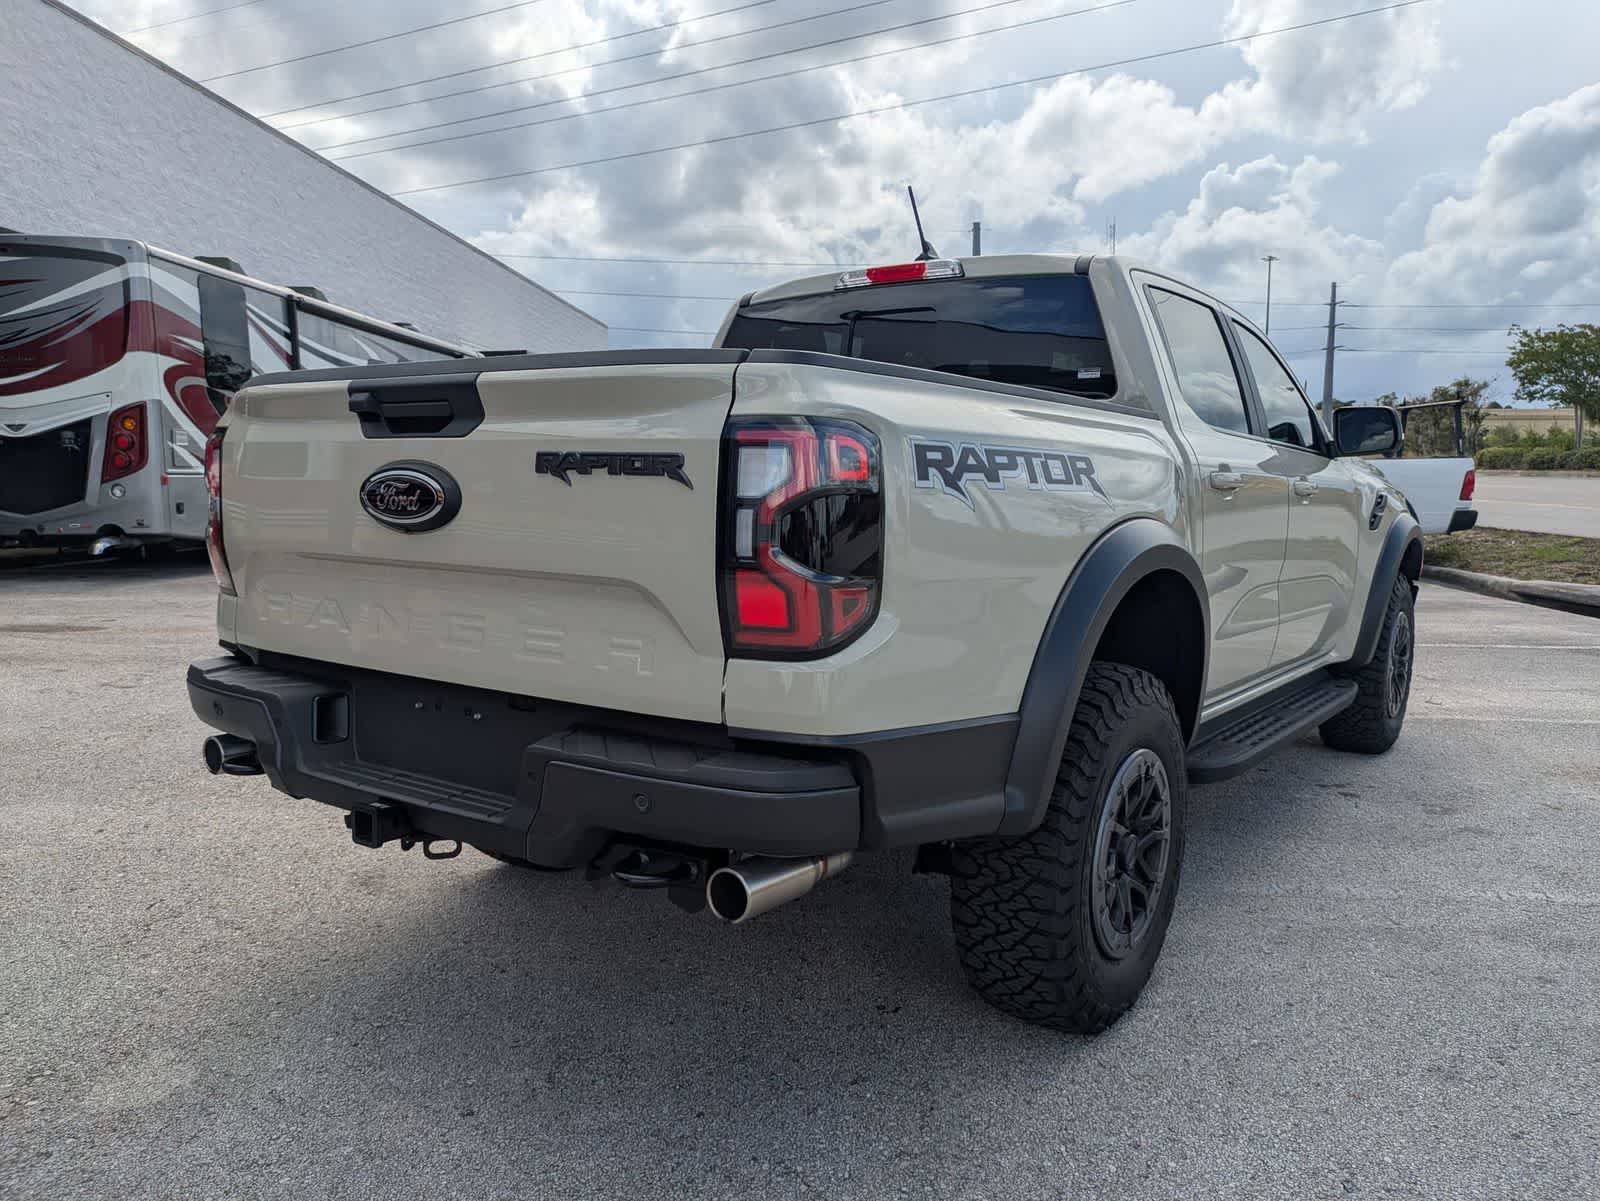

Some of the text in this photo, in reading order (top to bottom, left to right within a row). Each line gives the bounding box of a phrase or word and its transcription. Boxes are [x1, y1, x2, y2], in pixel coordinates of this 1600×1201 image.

[376, 481, 420, 511] Ford
[535, 452, 694, 490] RAPTOR
[912, 440, 1115, 510] RAPTOR
[257, 588, 656, 676] RANGER
